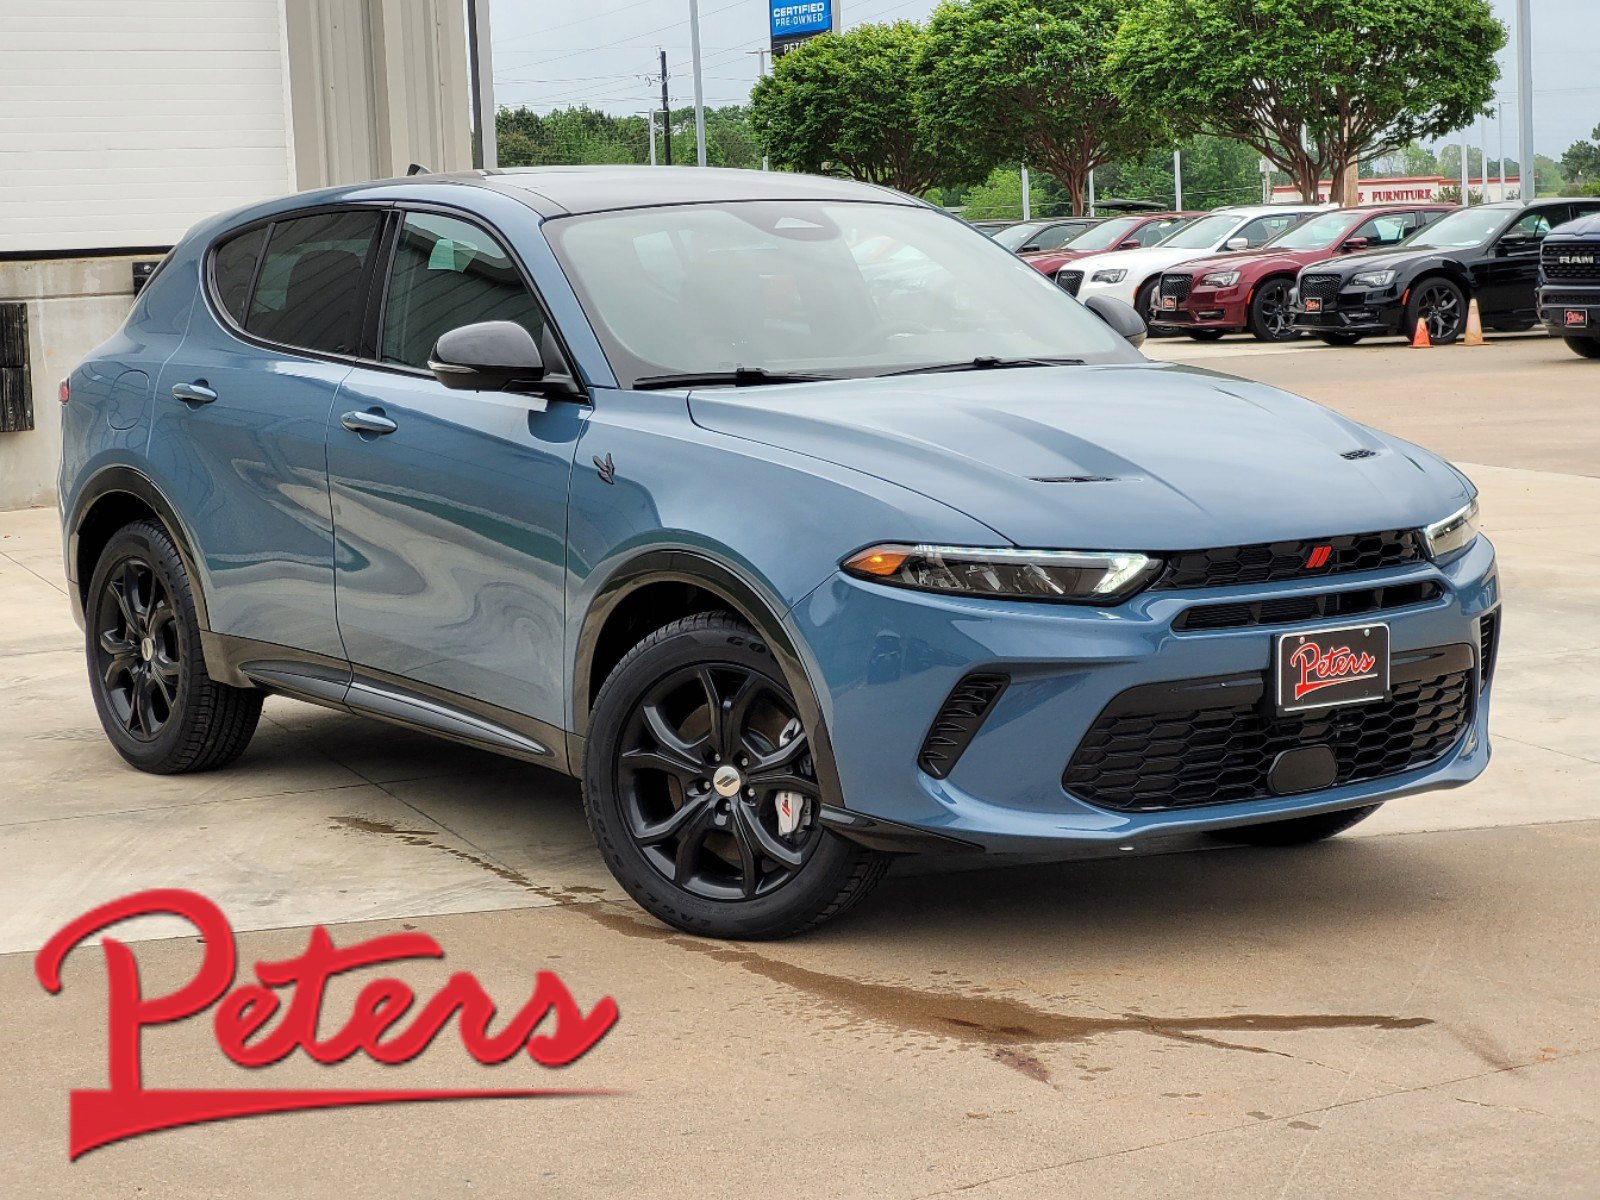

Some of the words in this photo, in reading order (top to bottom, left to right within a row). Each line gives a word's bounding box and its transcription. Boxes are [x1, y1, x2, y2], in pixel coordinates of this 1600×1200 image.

[773, 2, 825, 18] CERTIFIED
[776, 12, 823, 27] PRE-OWNED
[1372, 189, 1431, 202] FURNITURE
[1559, 256, 1594, 264] RAM
[1290, 642, 1376, 690] Peters
